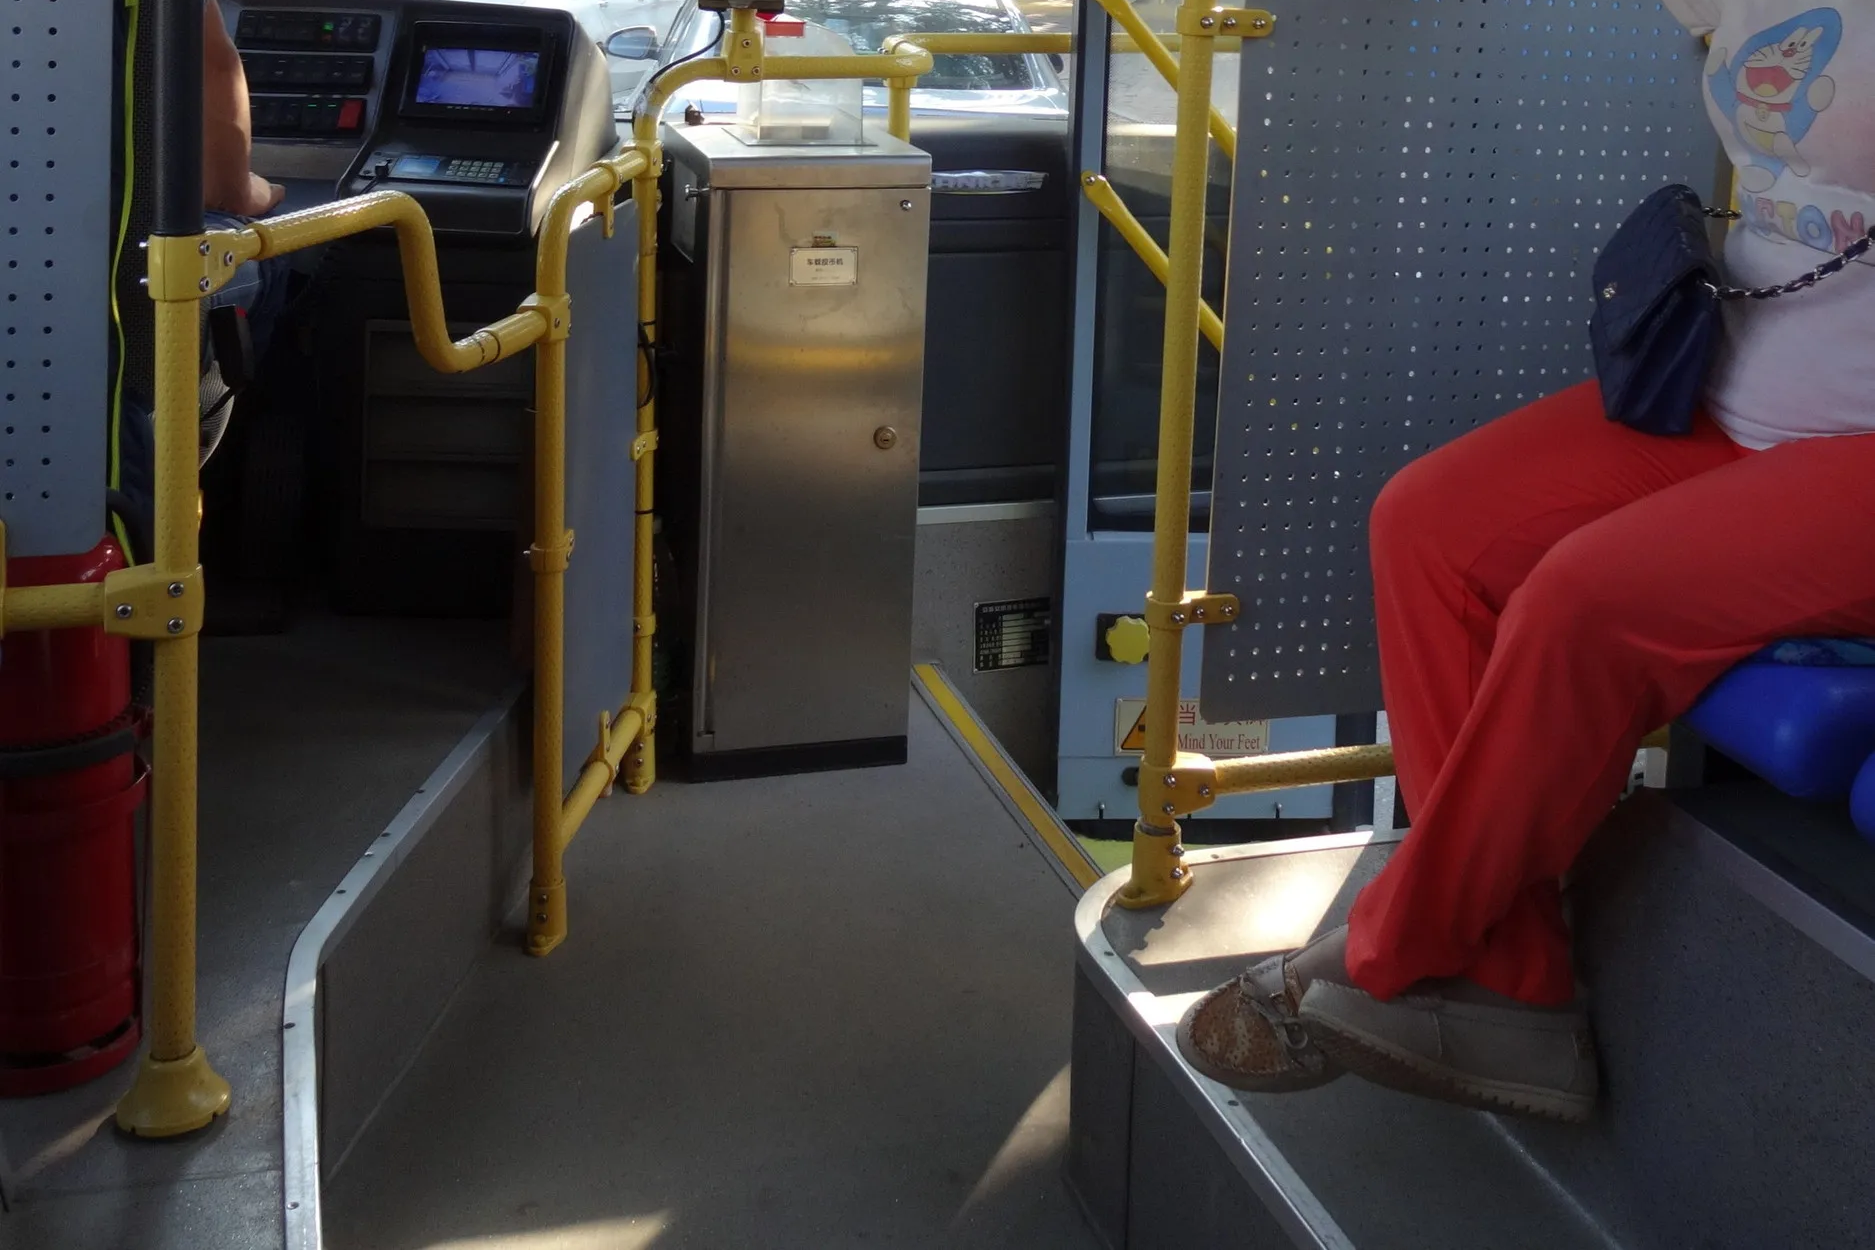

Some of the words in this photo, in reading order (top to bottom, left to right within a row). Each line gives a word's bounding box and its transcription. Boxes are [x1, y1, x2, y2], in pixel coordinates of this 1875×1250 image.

[1178, 733, 1205, 750] Mind
[1208, 733, 1235, 750] Your
[1237, 733, 1260, 750] Feet
